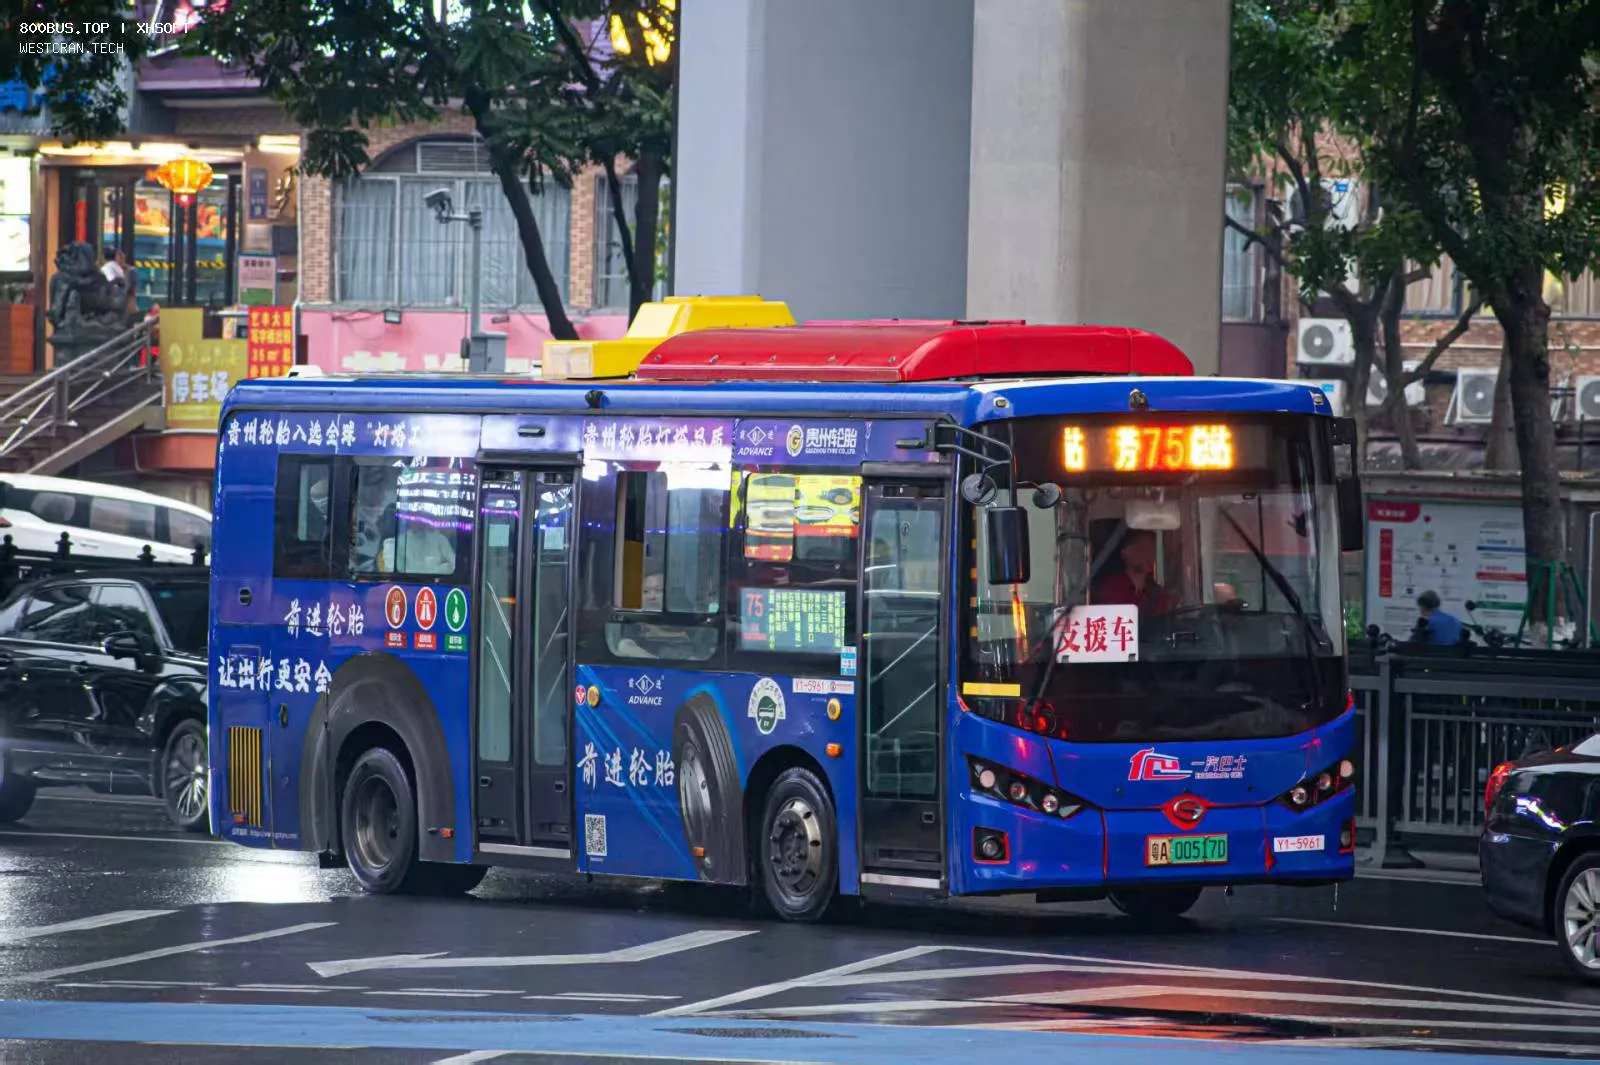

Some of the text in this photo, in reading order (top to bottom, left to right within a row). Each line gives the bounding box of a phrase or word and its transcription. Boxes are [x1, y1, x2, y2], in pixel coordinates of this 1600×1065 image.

[172, 371, 229, 404] 停车场
[738, 447, 774, 456] ADVANCE
[805, 427, 858, 448] 贵州轮胎
[1143, 427, 1186, 469] 75
[284, 598, 364, 637] 前进轮胎
[746, 594, 764, 617] 75
[1057, 616, 1134, 653] 支援车
[218, 655, 332, 693] 让出行更安全
[628, 696, 663, 706] ADVANCE
[576, 743, 675, 789] 前进轮胎
[1191, 755, 1247, 772] 一汽巴士
[1276, 837, 1321, 850] Y1-5961
